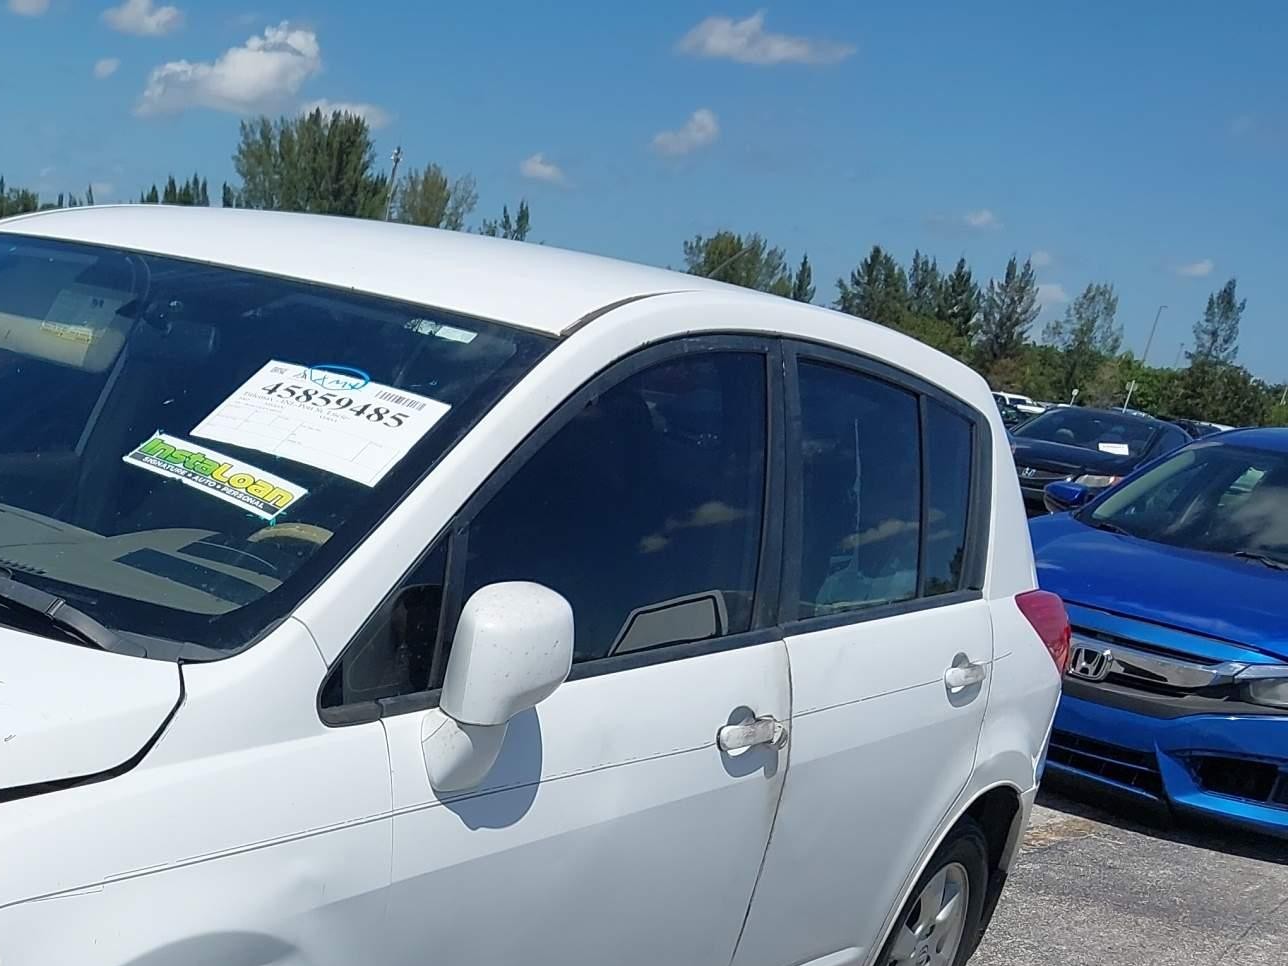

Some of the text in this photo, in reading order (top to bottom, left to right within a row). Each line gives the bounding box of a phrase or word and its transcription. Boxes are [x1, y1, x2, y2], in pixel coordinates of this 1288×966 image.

[261, 381, 411, 429] 45859485
[141, 455, 265, 510] SIGNATURE AUTO PERSONAL
